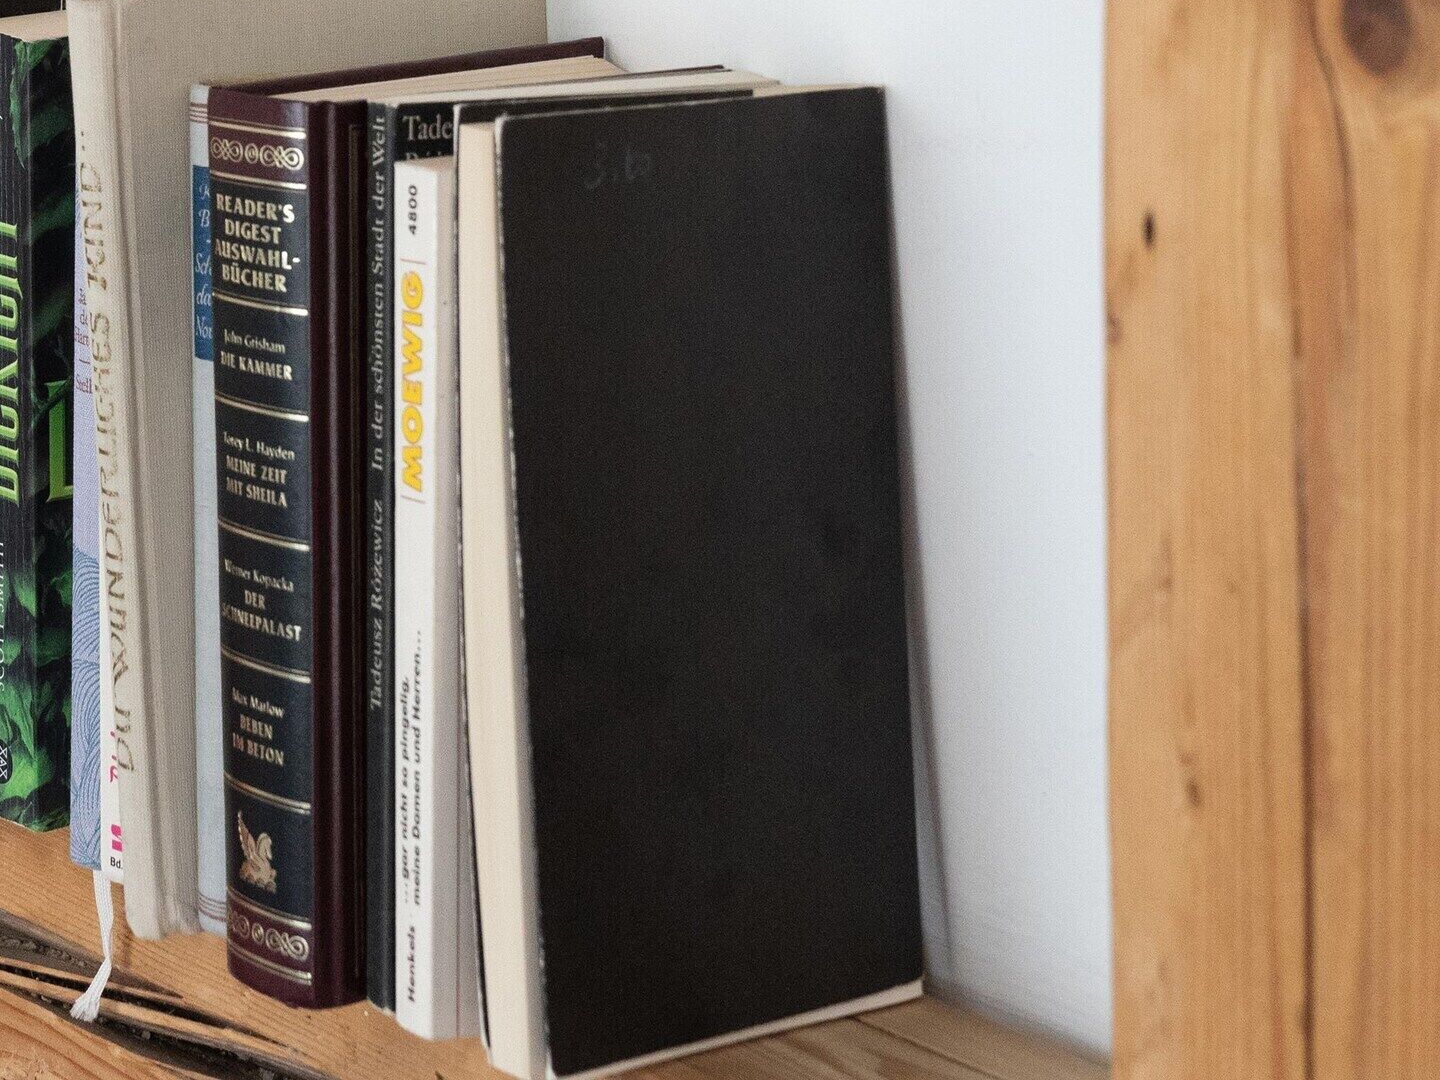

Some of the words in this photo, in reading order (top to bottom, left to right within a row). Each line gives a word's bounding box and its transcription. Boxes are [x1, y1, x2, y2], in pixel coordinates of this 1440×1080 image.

[372, 116, 386, 167] Welt
[215, 192, 295, 223] READER'S
[372, 172, 386, 211] der
[408, 185, 418, 235] 4800
[224, 218, 282, 244] DIGEST
[372, 216, 385, 276] Stadt
[214, 238, 300, 270] AUSWAHL-
[221, 261, 287, 293] BÜCHER
[223, 328, 243, 344] John
[244, 335, 286, 354] Grisham
[371, 283, 385, 394] schönsten
[221, 351, 236, 369] DIE
[239, 356, 293, 381] KAMMER
[401, 272, 424, 492] MOEWIG
[371, 401, 384, 440] der
[226, 454, 257, 478] MEINE
[261, 465, 288, 485] ZEIT
[256, 440, 295, 461] Hayden
[371, 449, 383, 471] In
[226, 476, 243, 496] MIT
[246, 483, 288, 509] SHEILA
[244, 589, 266, 610] DER
[370, 617, 383, 710] Tadeusz
[413, 726, 423, 764] und
[401, 794, 410, 840] nicht
[413, 771, 422, 839] Damen
[412, 846, 421, 906] meine
[406, 925, 415, 1003] Henkels
